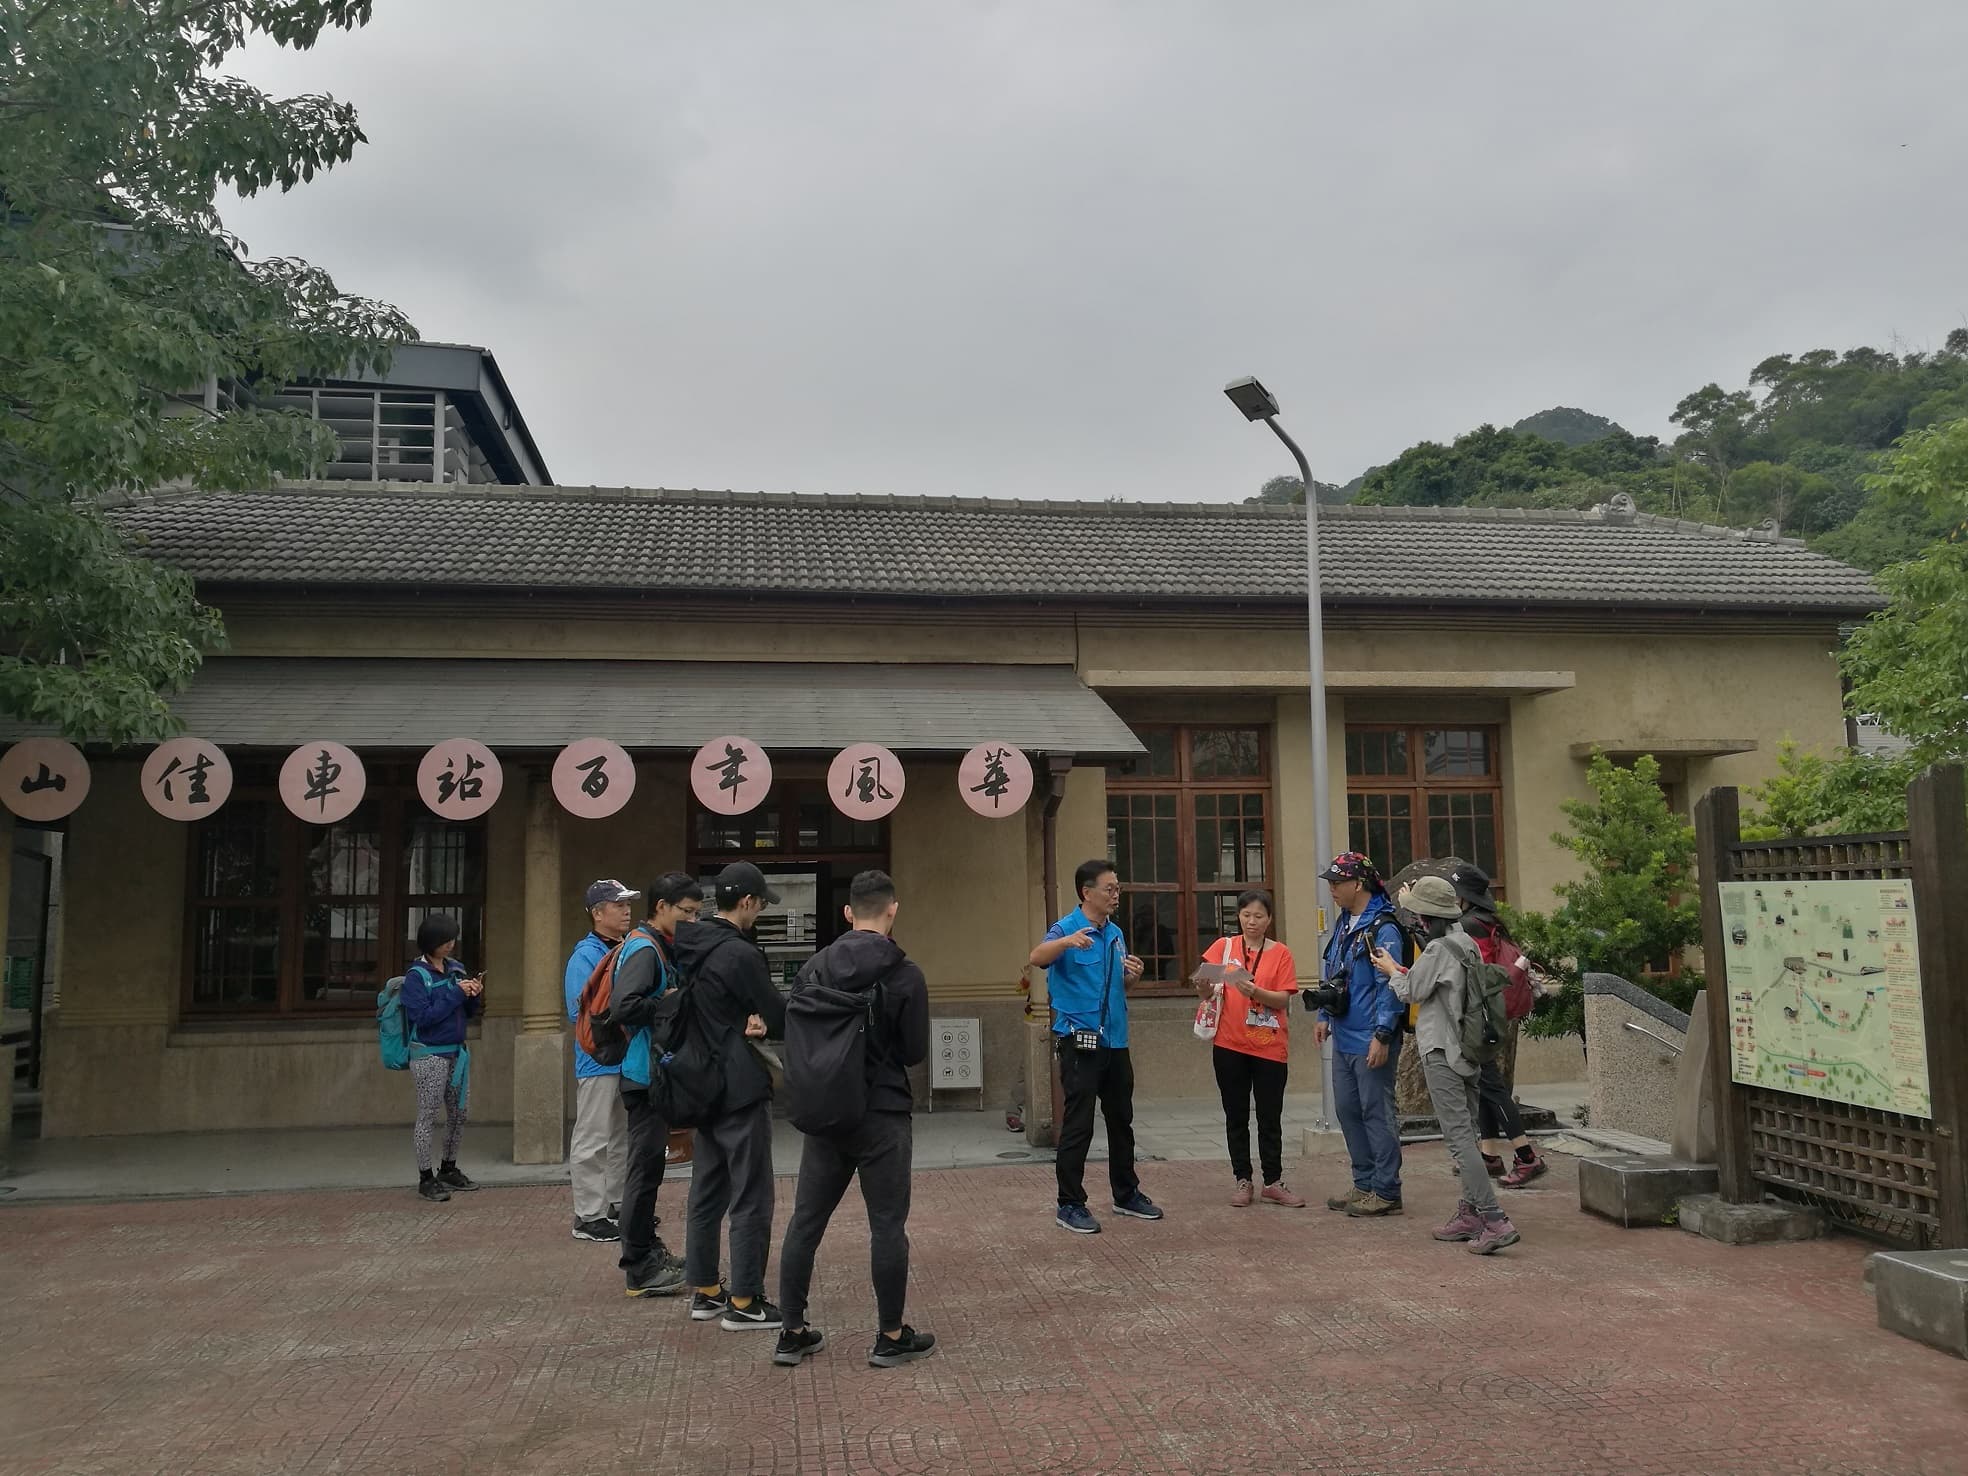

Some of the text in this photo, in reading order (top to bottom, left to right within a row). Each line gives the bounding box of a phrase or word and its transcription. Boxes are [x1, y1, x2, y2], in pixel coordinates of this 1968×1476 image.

[20, 742, 1012, 813] 山佳車站百年風華
